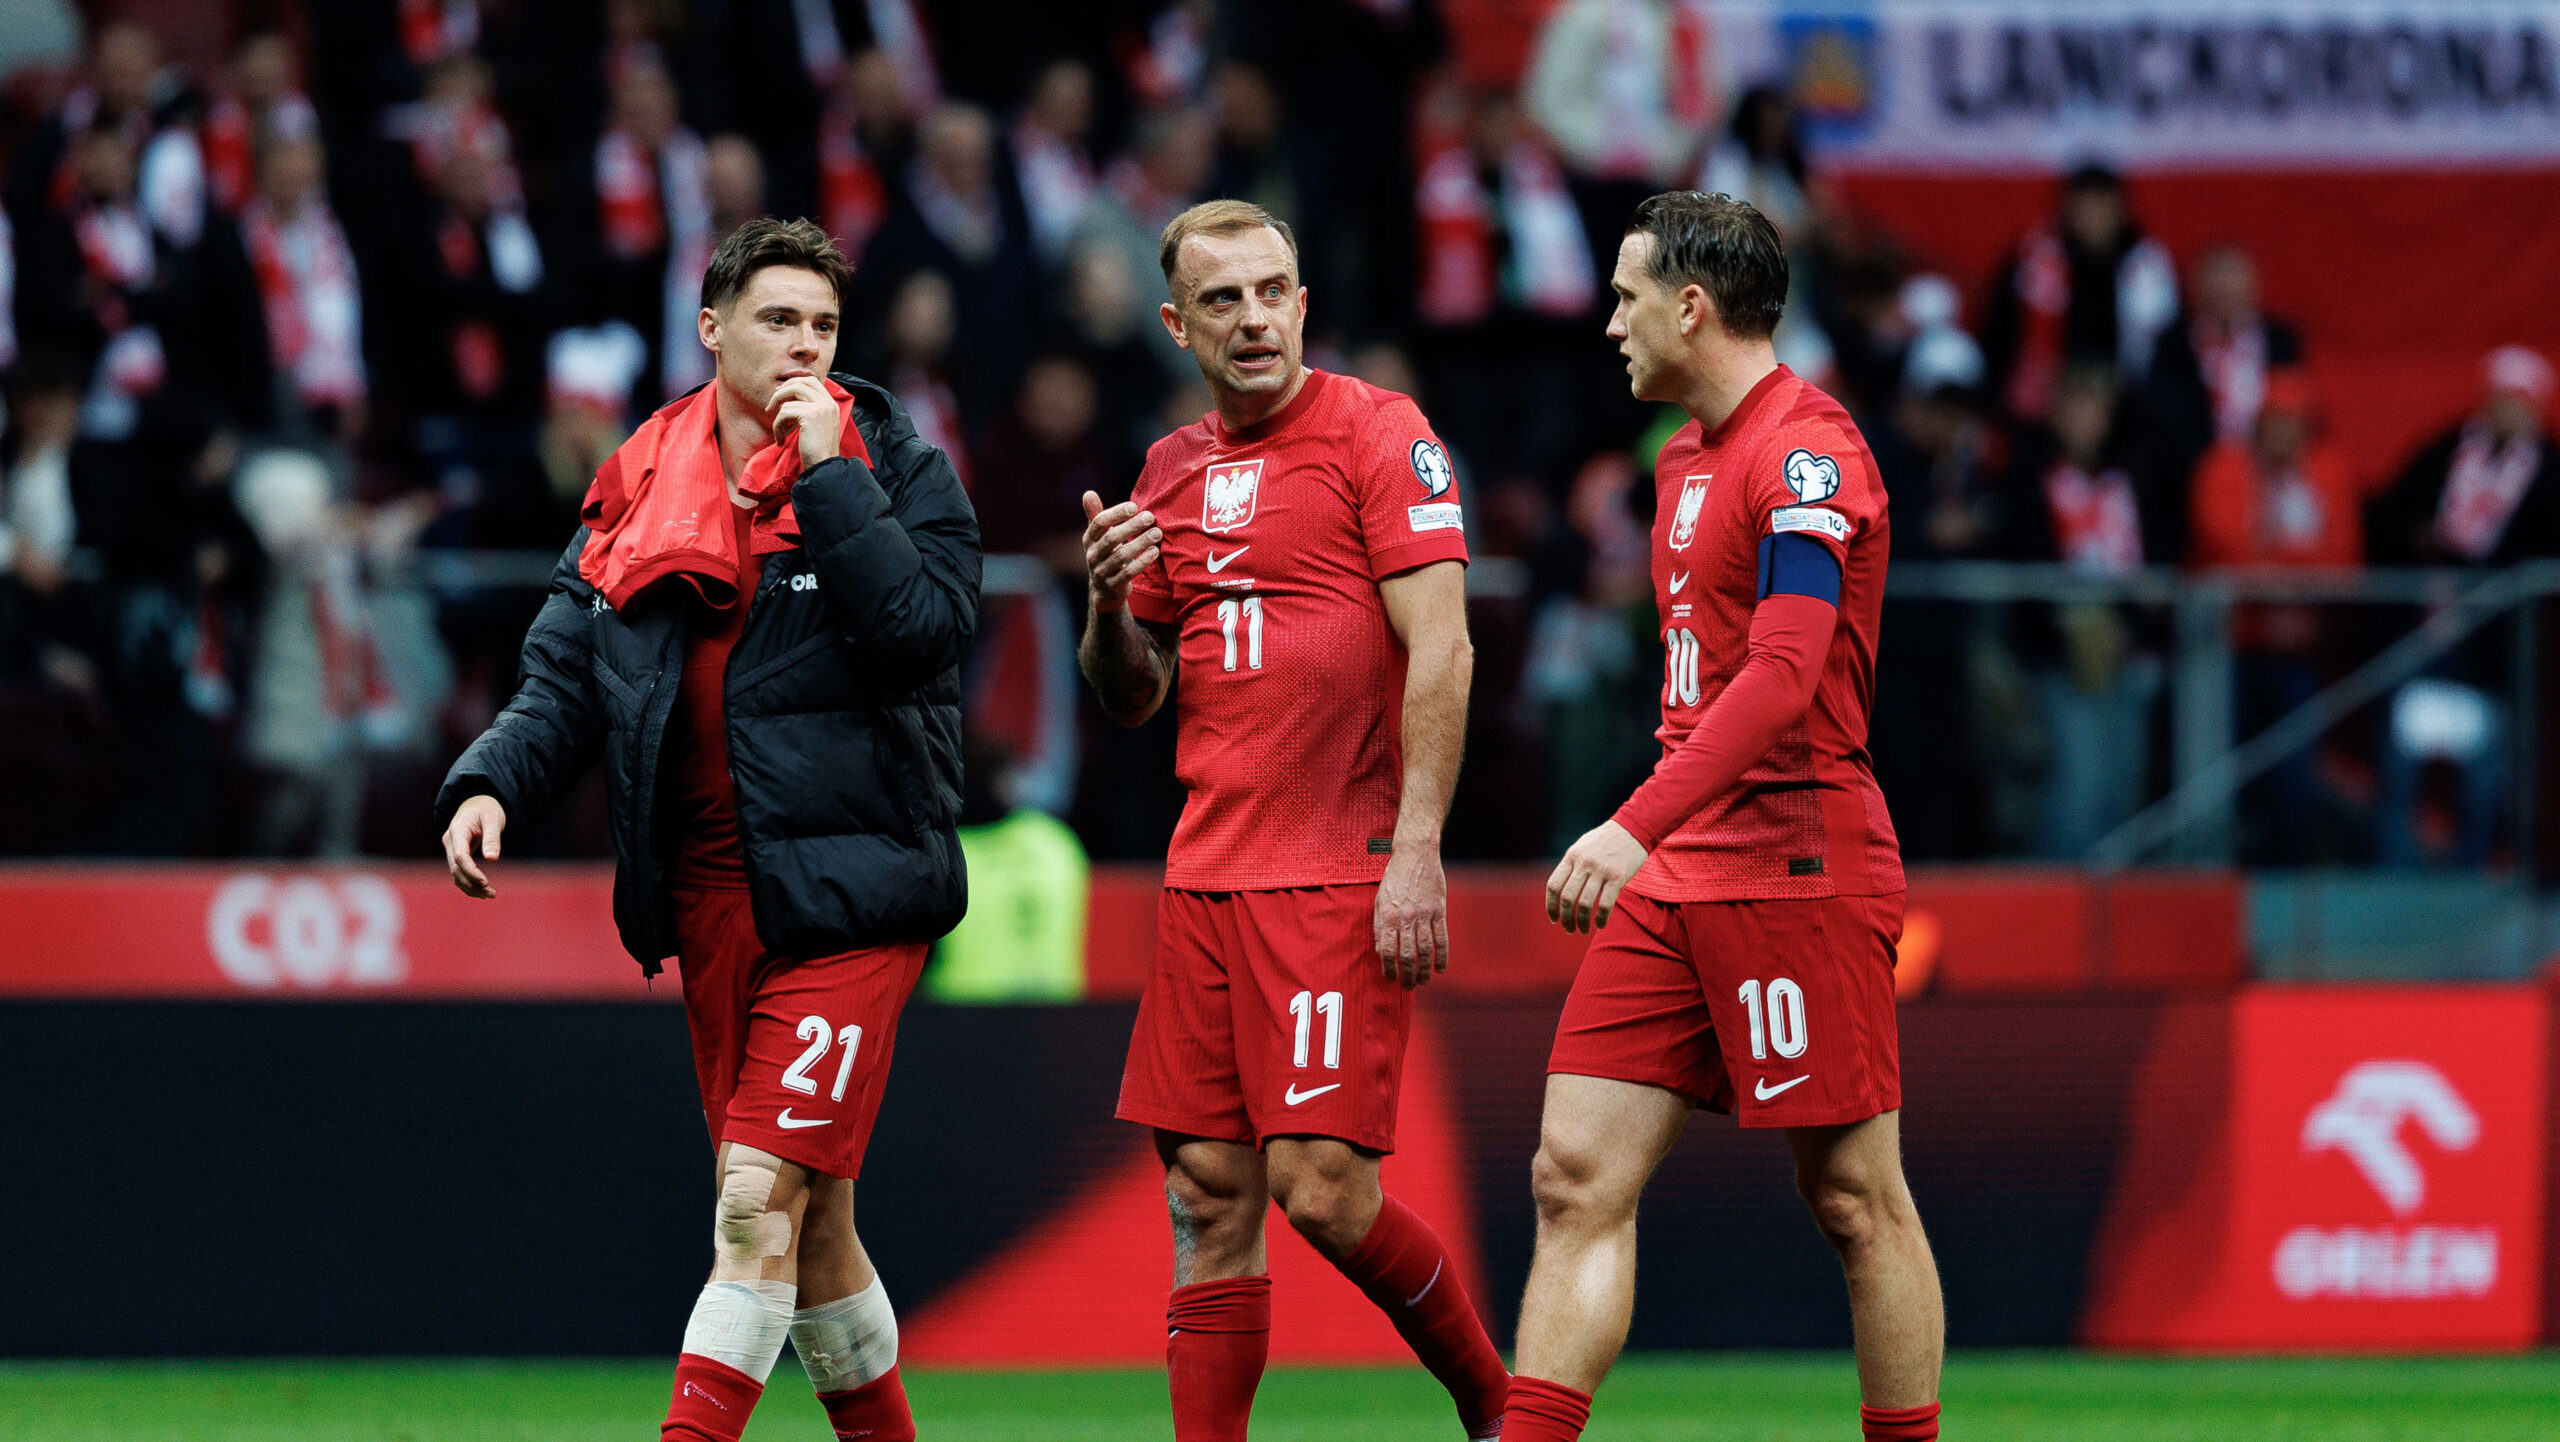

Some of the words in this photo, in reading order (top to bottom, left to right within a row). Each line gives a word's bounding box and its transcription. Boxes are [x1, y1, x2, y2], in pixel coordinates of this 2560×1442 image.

[1217, 595, 1264, 672] 11
[1666, 627, 1701, 707] 10
[1289, 990, 1343, 1070] 11
[1738, 977, 1809, 1060] 10
[781, 1015, 862, 1103] 21
